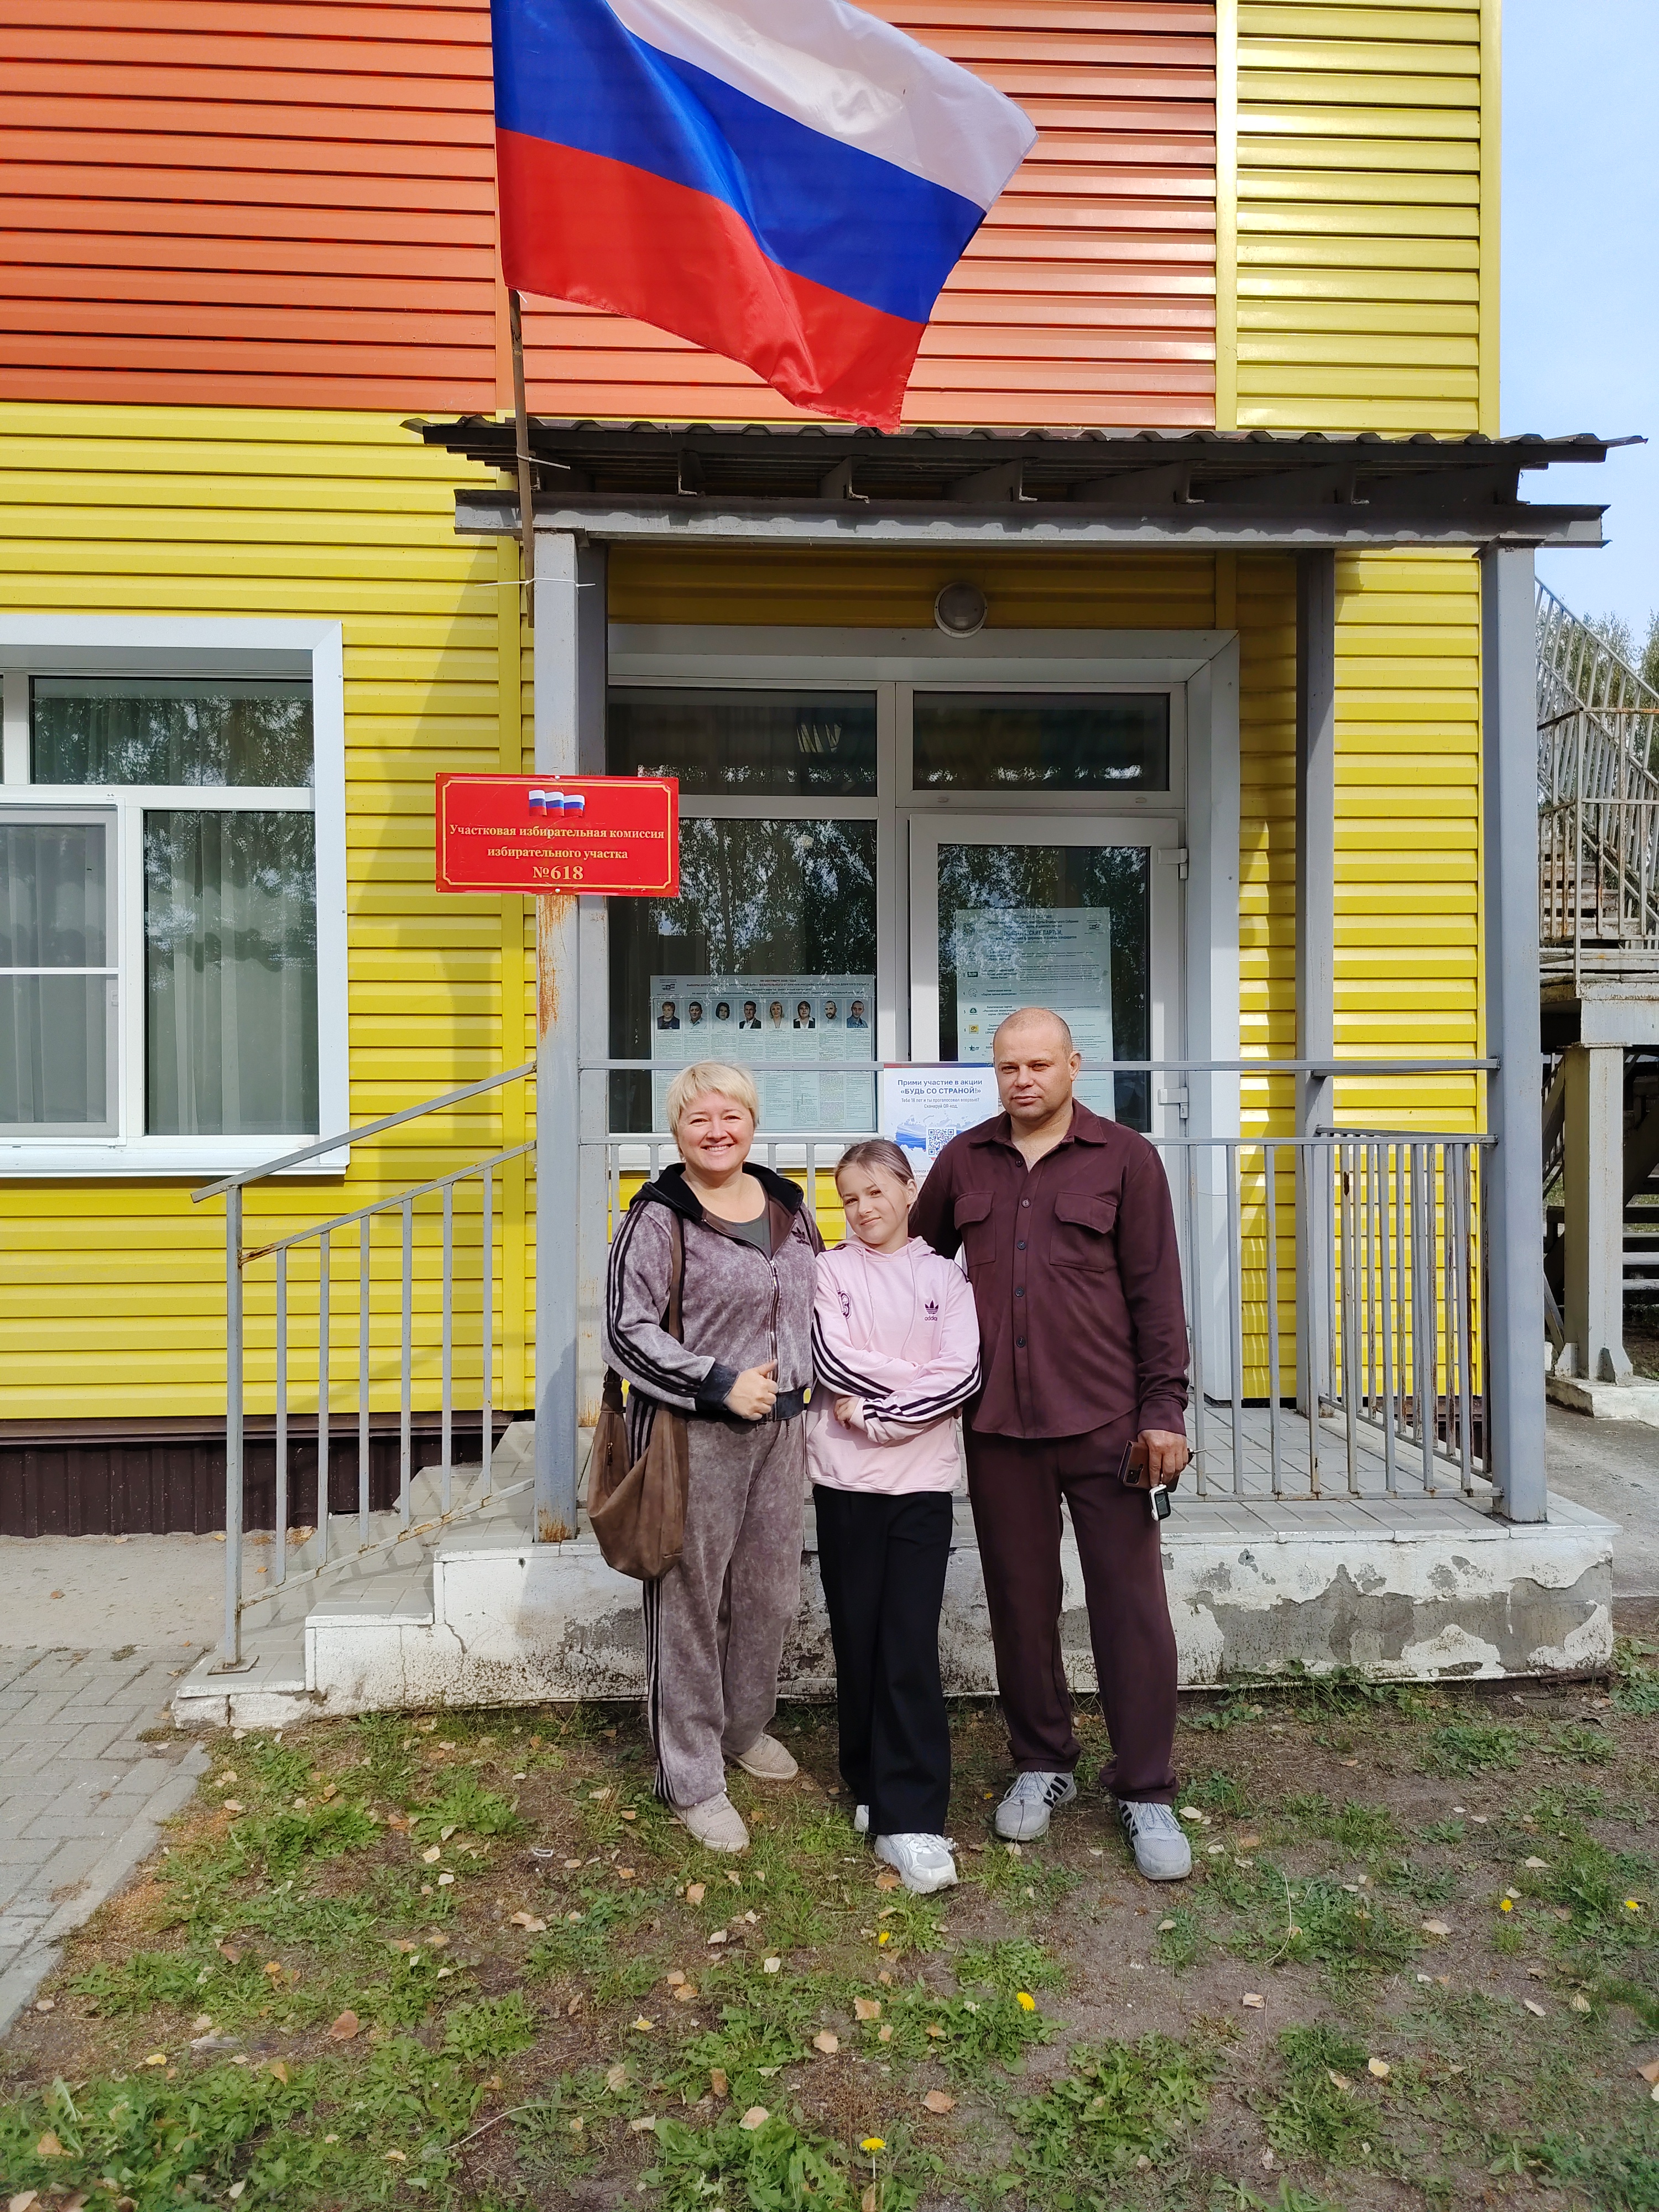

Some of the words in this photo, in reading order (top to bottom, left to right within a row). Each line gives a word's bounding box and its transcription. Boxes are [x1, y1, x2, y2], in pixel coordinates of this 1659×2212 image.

[450, 824, 516, 836] Участковая
[519, 825, 607, 838] избирательная
[609, 830, 665, 839] комиссия
[487, 846, 581, 859] избирательного
[583, 851, 628, 860] участка
[533, 865, 583, 880] №618
